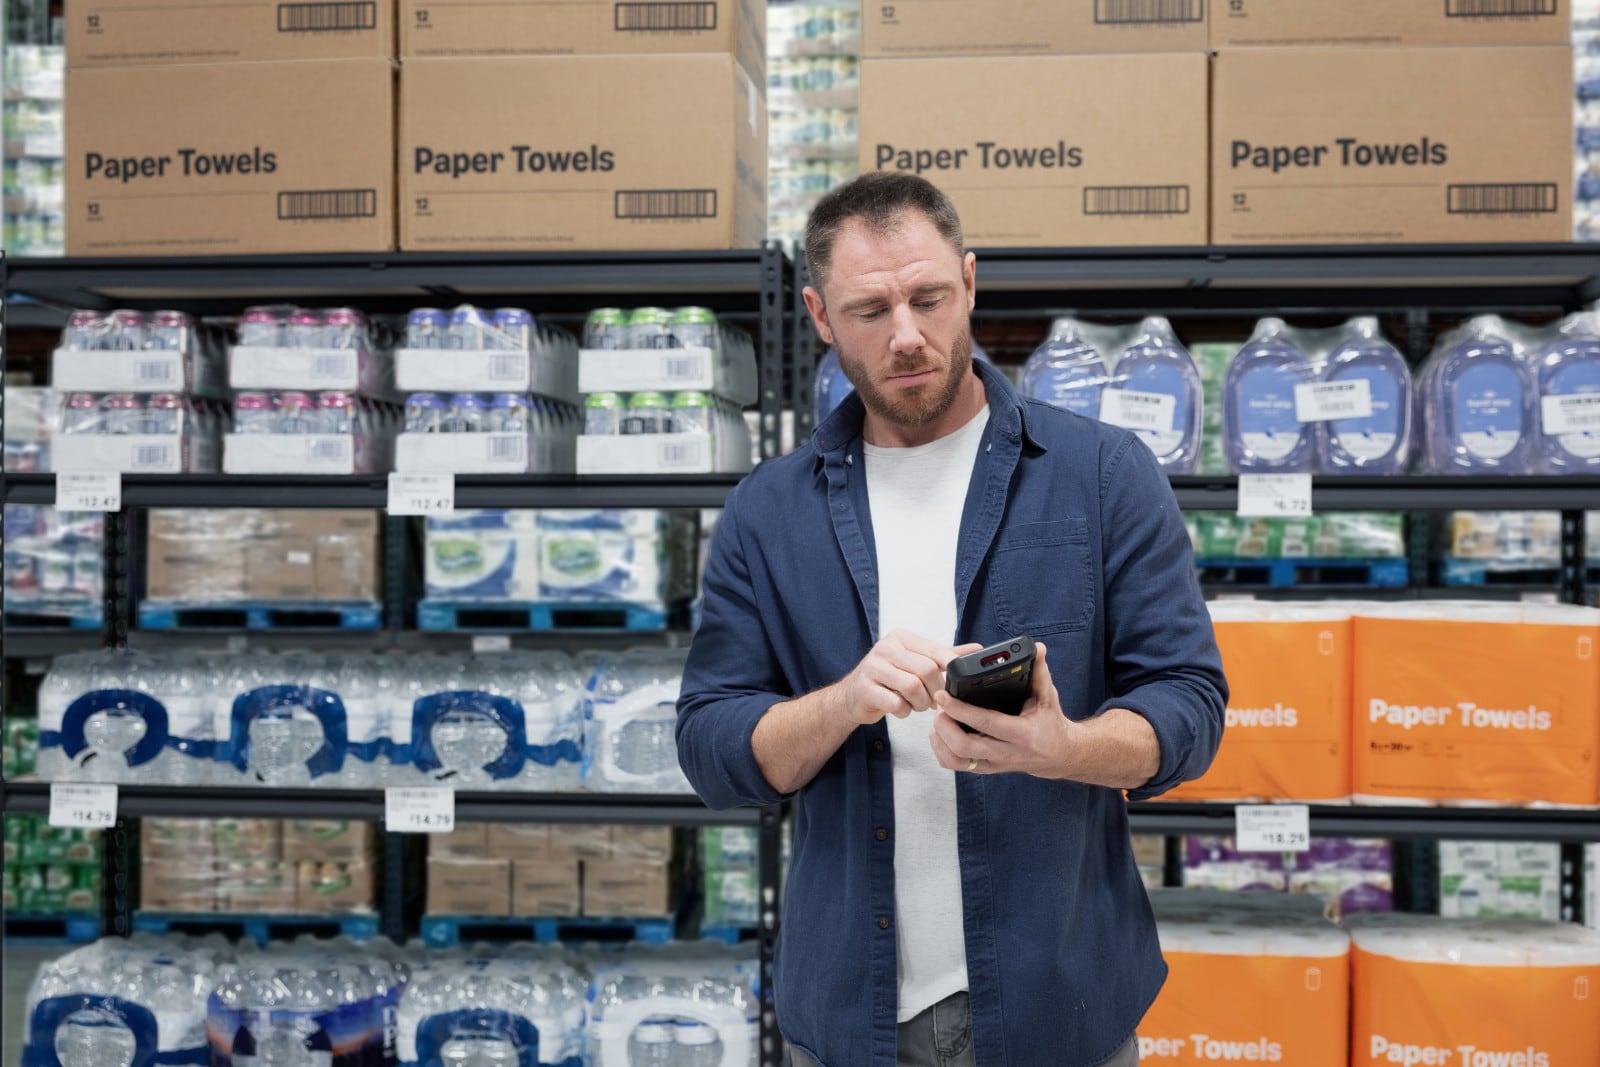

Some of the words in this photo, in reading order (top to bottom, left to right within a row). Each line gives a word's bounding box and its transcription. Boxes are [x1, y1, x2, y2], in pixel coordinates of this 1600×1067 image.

[85, 152, 171, 183] Paper
[178, 147, 277, 176] Towels
[414, 146, 505, 179] Paper
[511, 145, 615, 173] Towels
[876, 144, 968, 174] Paper
[976, 141, 1083, 169] Towels
[1231, 141, 1328, 173] Paper
[1336, 137, 1448, 166] Towels
[1225, 703, 1298, 727] owels
[1369, 698, 1452, 729] Paper
[1456, 702, 1552, 730] Towels
[1139, 1036, 1185, 1060] per
[1190, 1034, 1282, 1061] Towels
[1371, 1034, 1452, 1067] Paper
[1456, 1045, 1551, 1067] Towels
